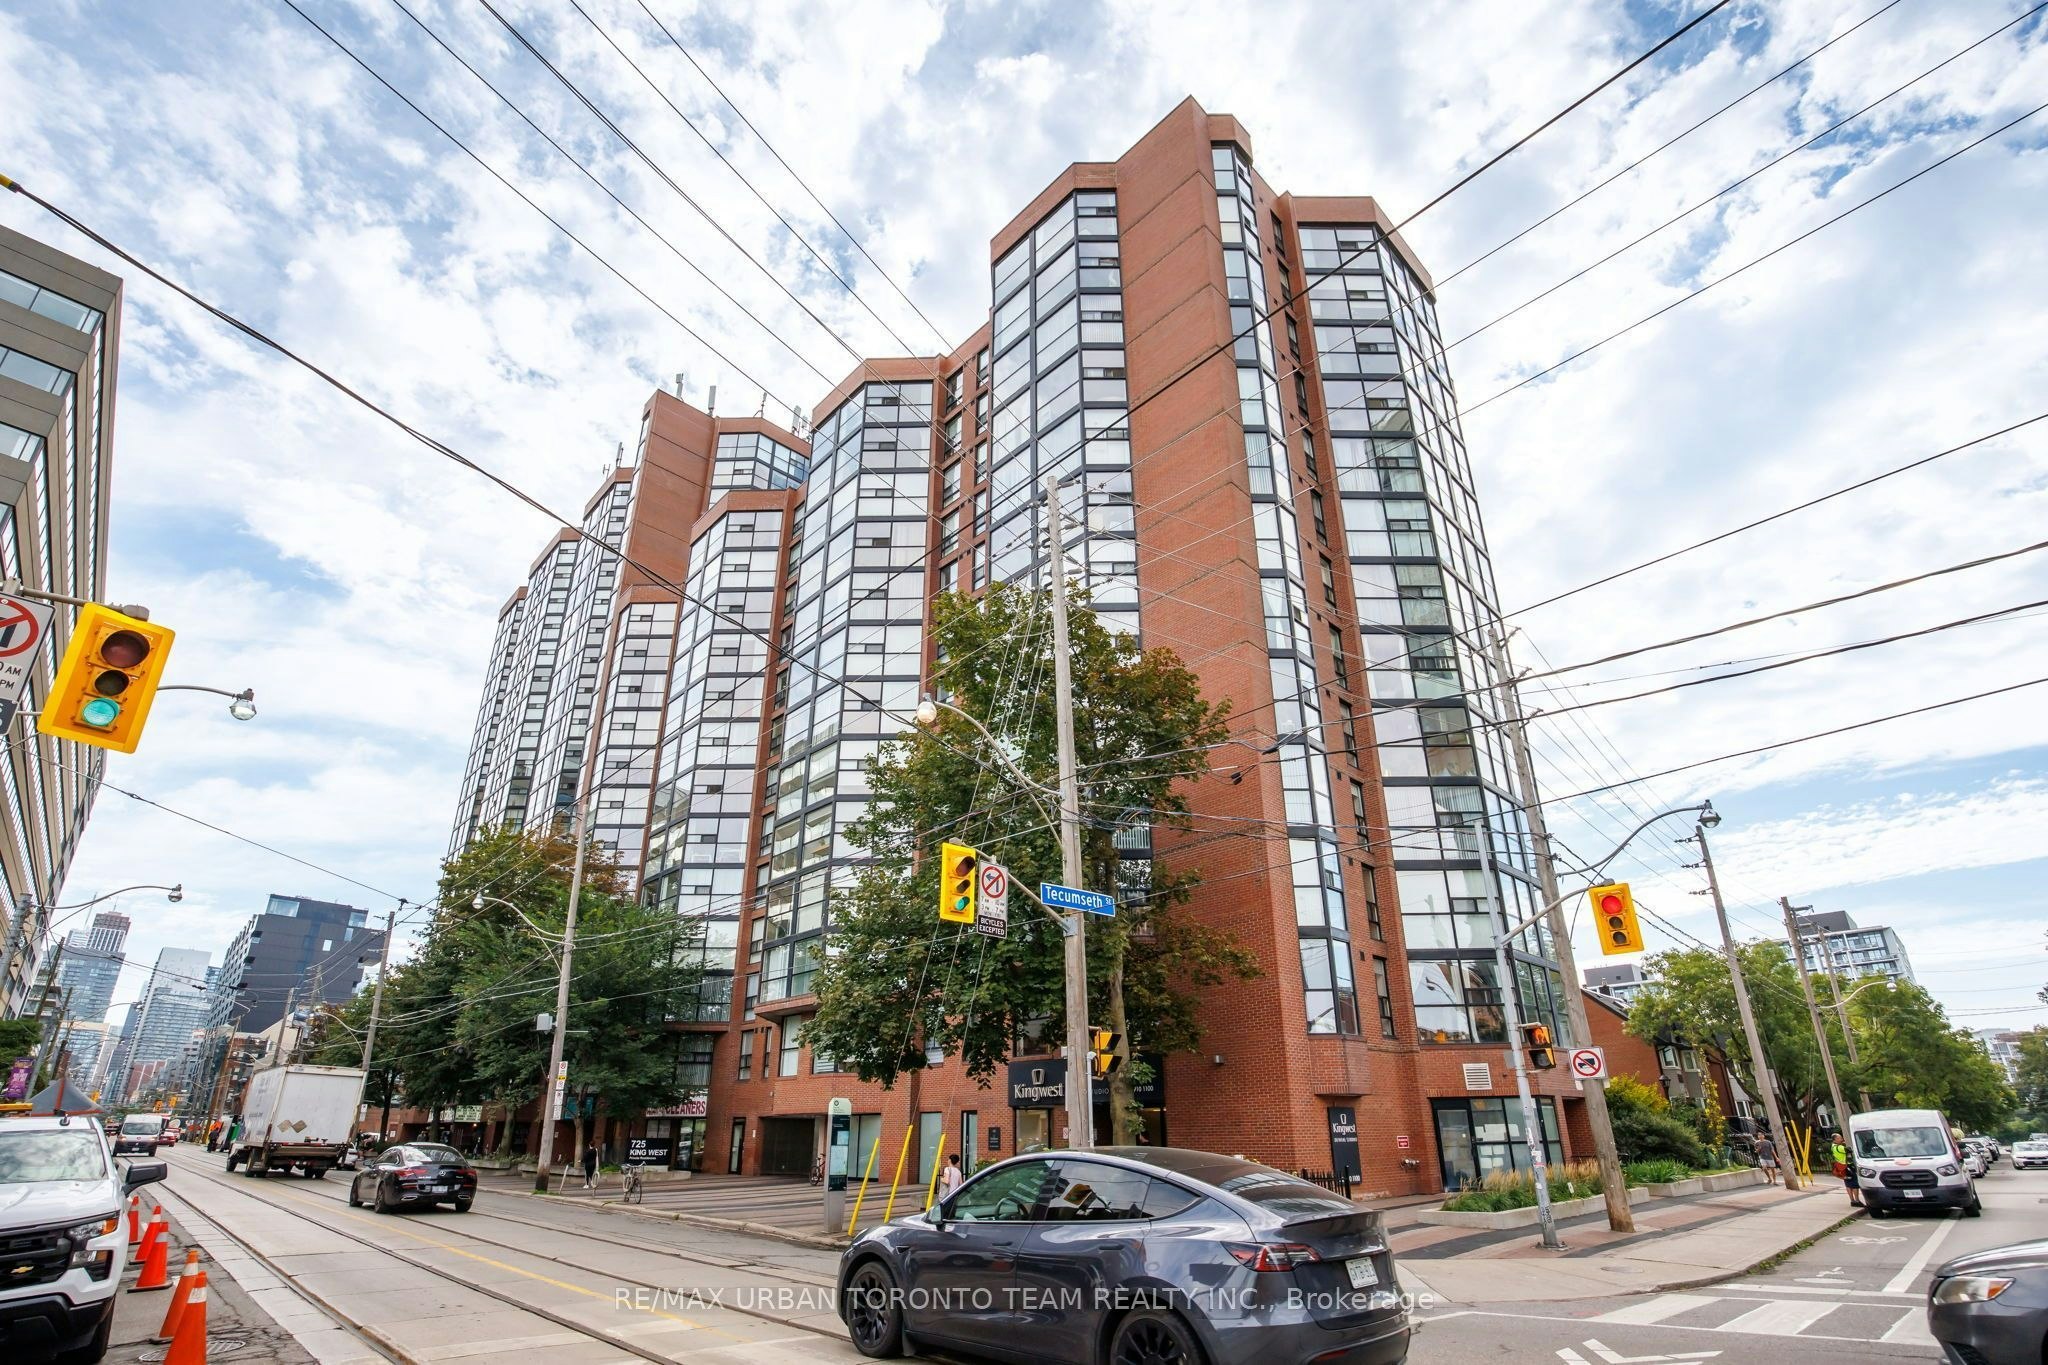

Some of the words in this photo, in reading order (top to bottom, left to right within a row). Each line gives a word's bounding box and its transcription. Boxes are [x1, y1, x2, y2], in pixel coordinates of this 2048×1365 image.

[5, 666, 22, 676] AM
[1045, 886, 1103, 908] Tecumseth
[980, 917, 1004, 928] BICYCLES
[979, 924, 1005, 935] EXCEPTED
[1014, 1083, 1065, 1101] Kingwest
[631, 1140, 646, 1148] 725
[648, 1148, 668, 1156] WEST
